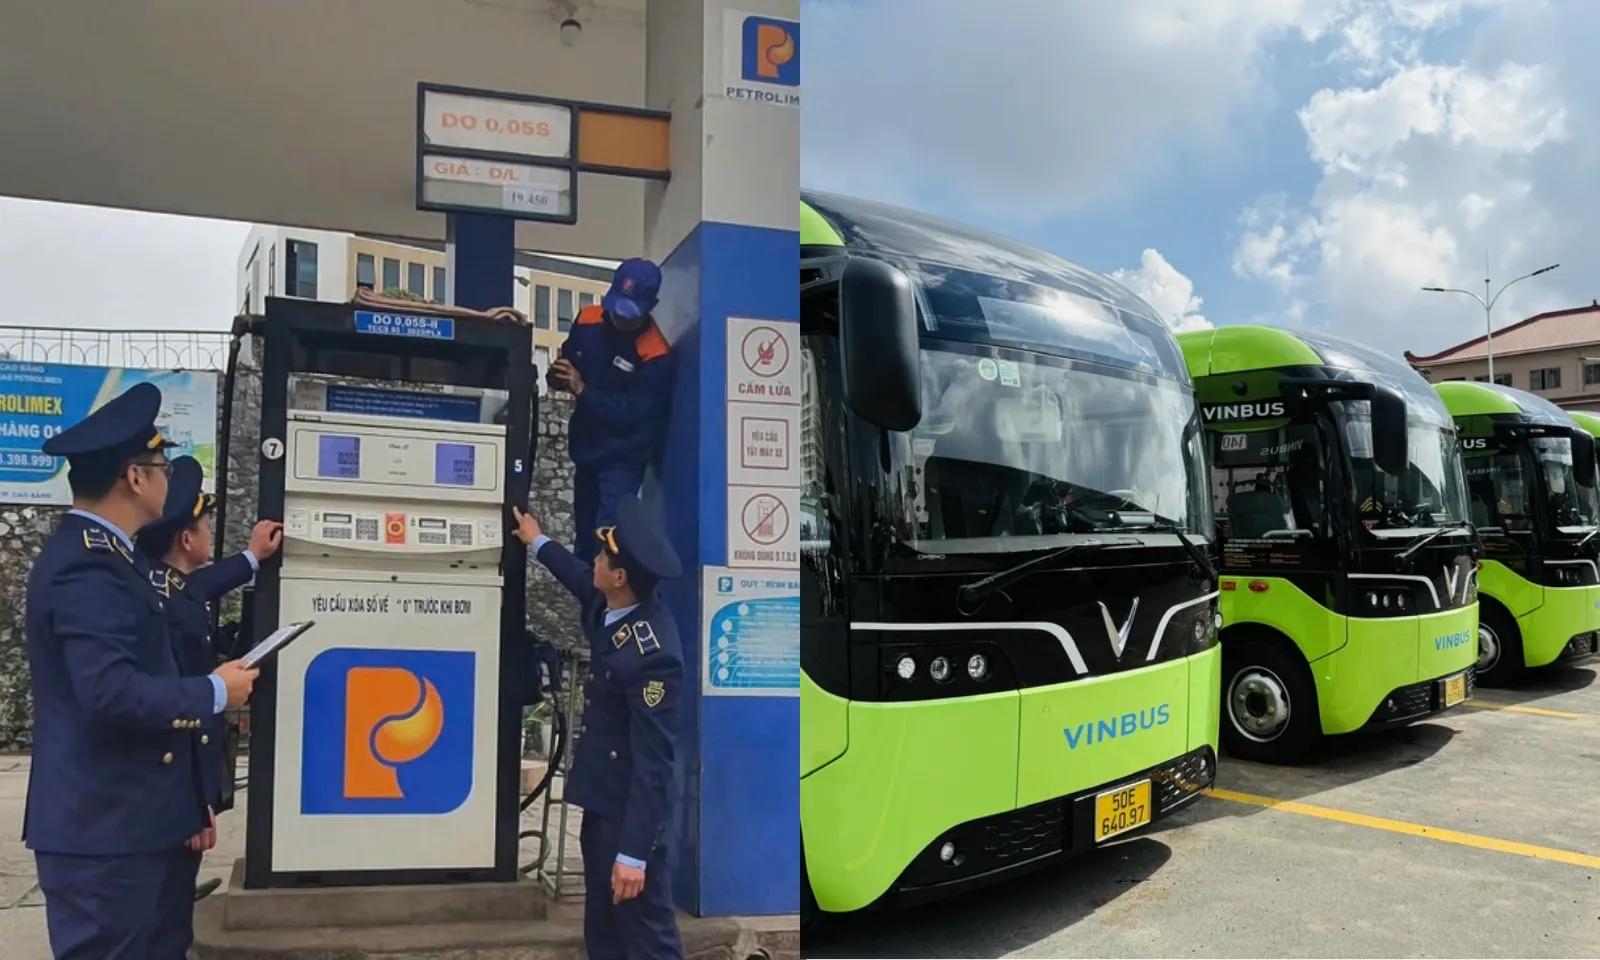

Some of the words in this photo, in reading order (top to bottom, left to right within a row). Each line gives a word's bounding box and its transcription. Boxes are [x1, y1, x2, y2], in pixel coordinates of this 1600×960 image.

[441, 113, 477, 130] DO
[434, 162, 470, 177] GIÁ
[373, 315, 391, 325] DO
[1203, 402, 1285, 420] VINBUS
[269, 443, 278, 457] 7
[1463, 438, 1487, 449] US
[514, 458, 522, 472] 5
[1434, 631, 1470, 650] VINBUS
[1063, 704, 1170, 750] VINBUS
[1112, 788, 1136, 812] 50E
[1102, 804, 1145, 836] 640.97
